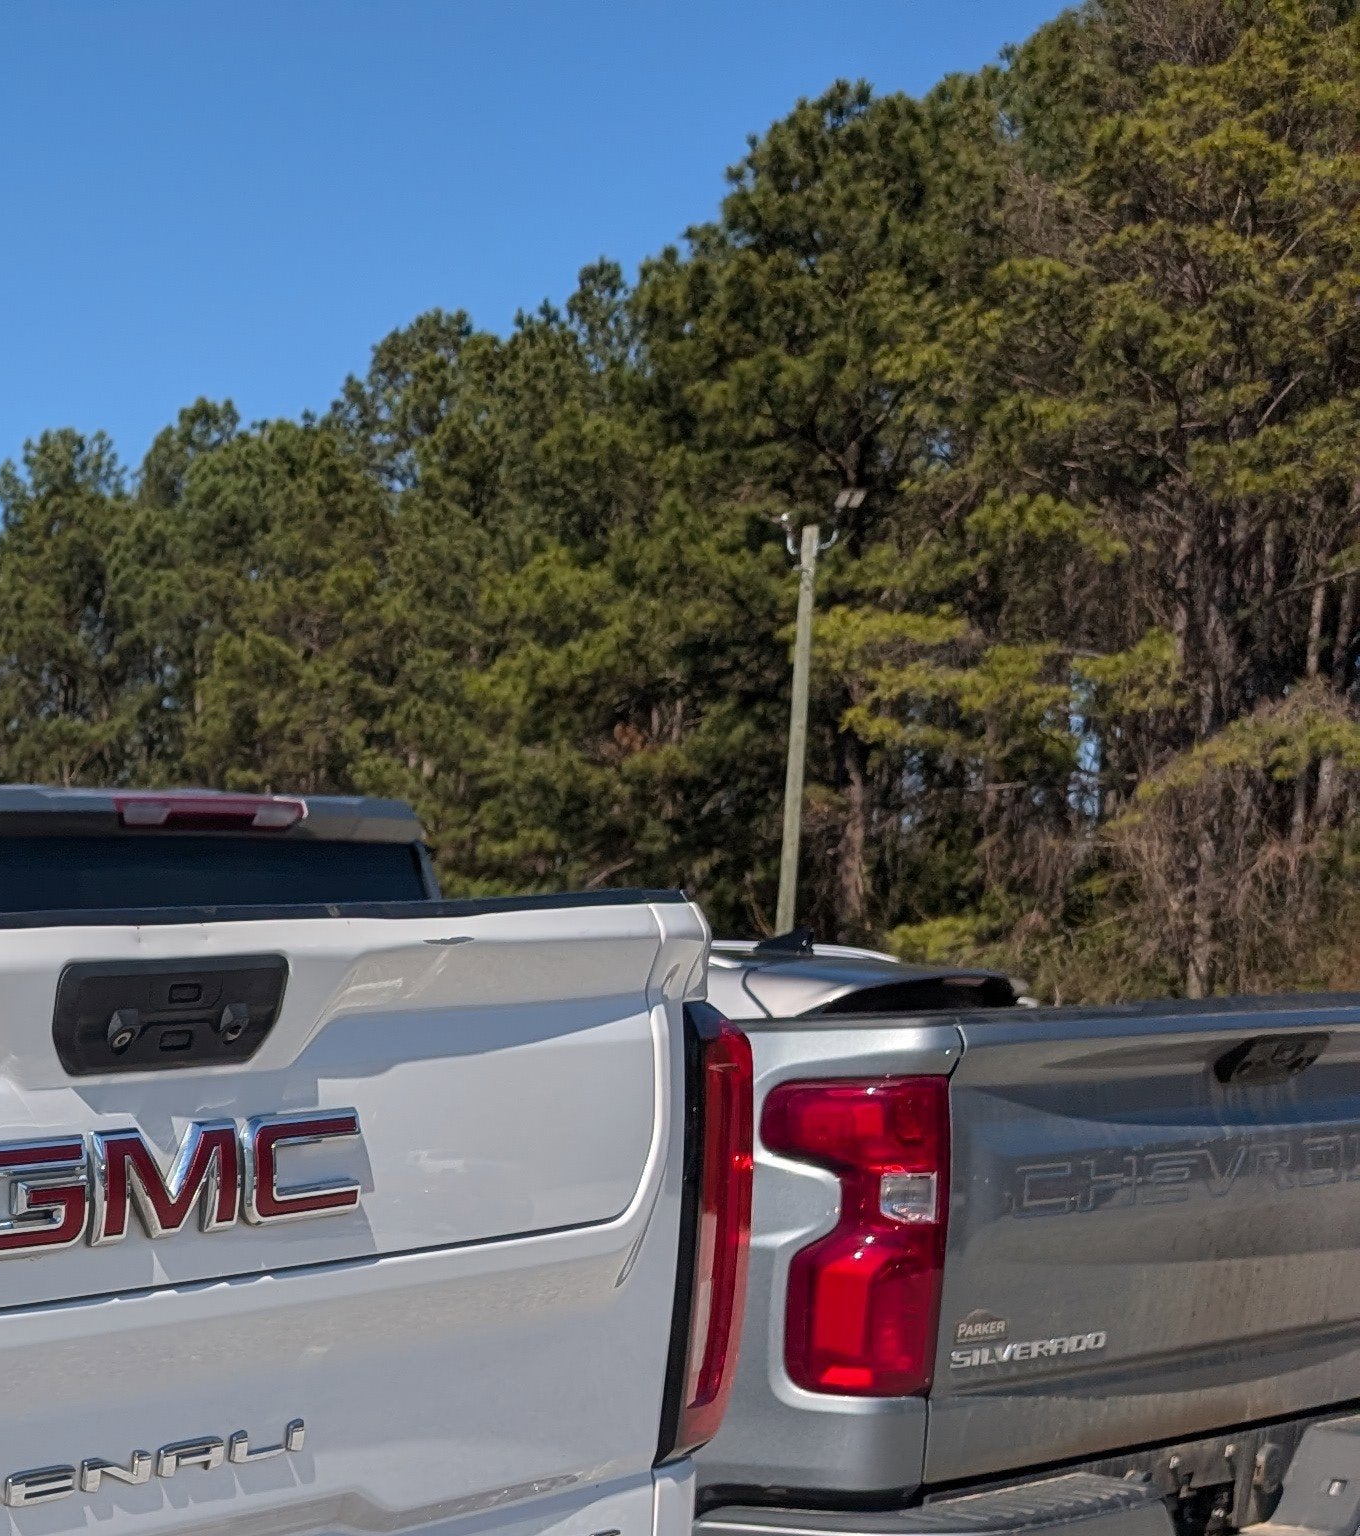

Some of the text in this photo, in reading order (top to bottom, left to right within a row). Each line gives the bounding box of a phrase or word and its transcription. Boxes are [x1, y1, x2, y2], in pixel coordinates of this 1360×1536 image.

[1011, 1131, 1360, 1219] CHEVRO
[957, 1320, 1007, 1338] PARKER
[949, 1330, 1108, 1370] SILVERADO
